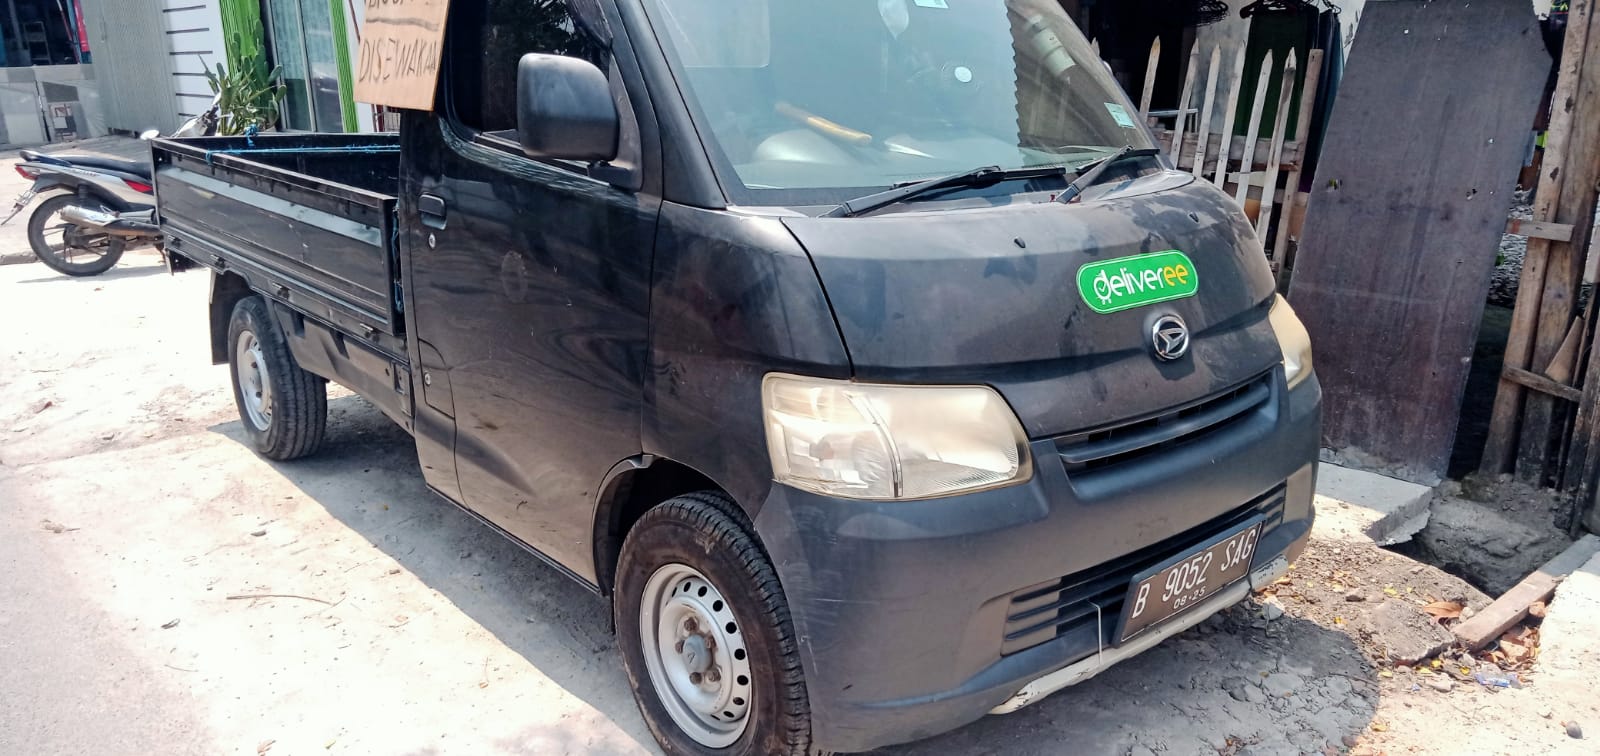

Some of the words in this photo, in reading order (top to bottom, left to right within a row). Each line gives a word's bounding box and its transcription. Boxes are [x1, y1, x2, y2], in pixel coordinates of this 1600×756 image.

[1093, 264, 1189, 304] deliveree
[1132, 582, 1150, 618] B
[1162, 551, 1213, 601] 9052
[1221, 529, 1256, 571] SAG
